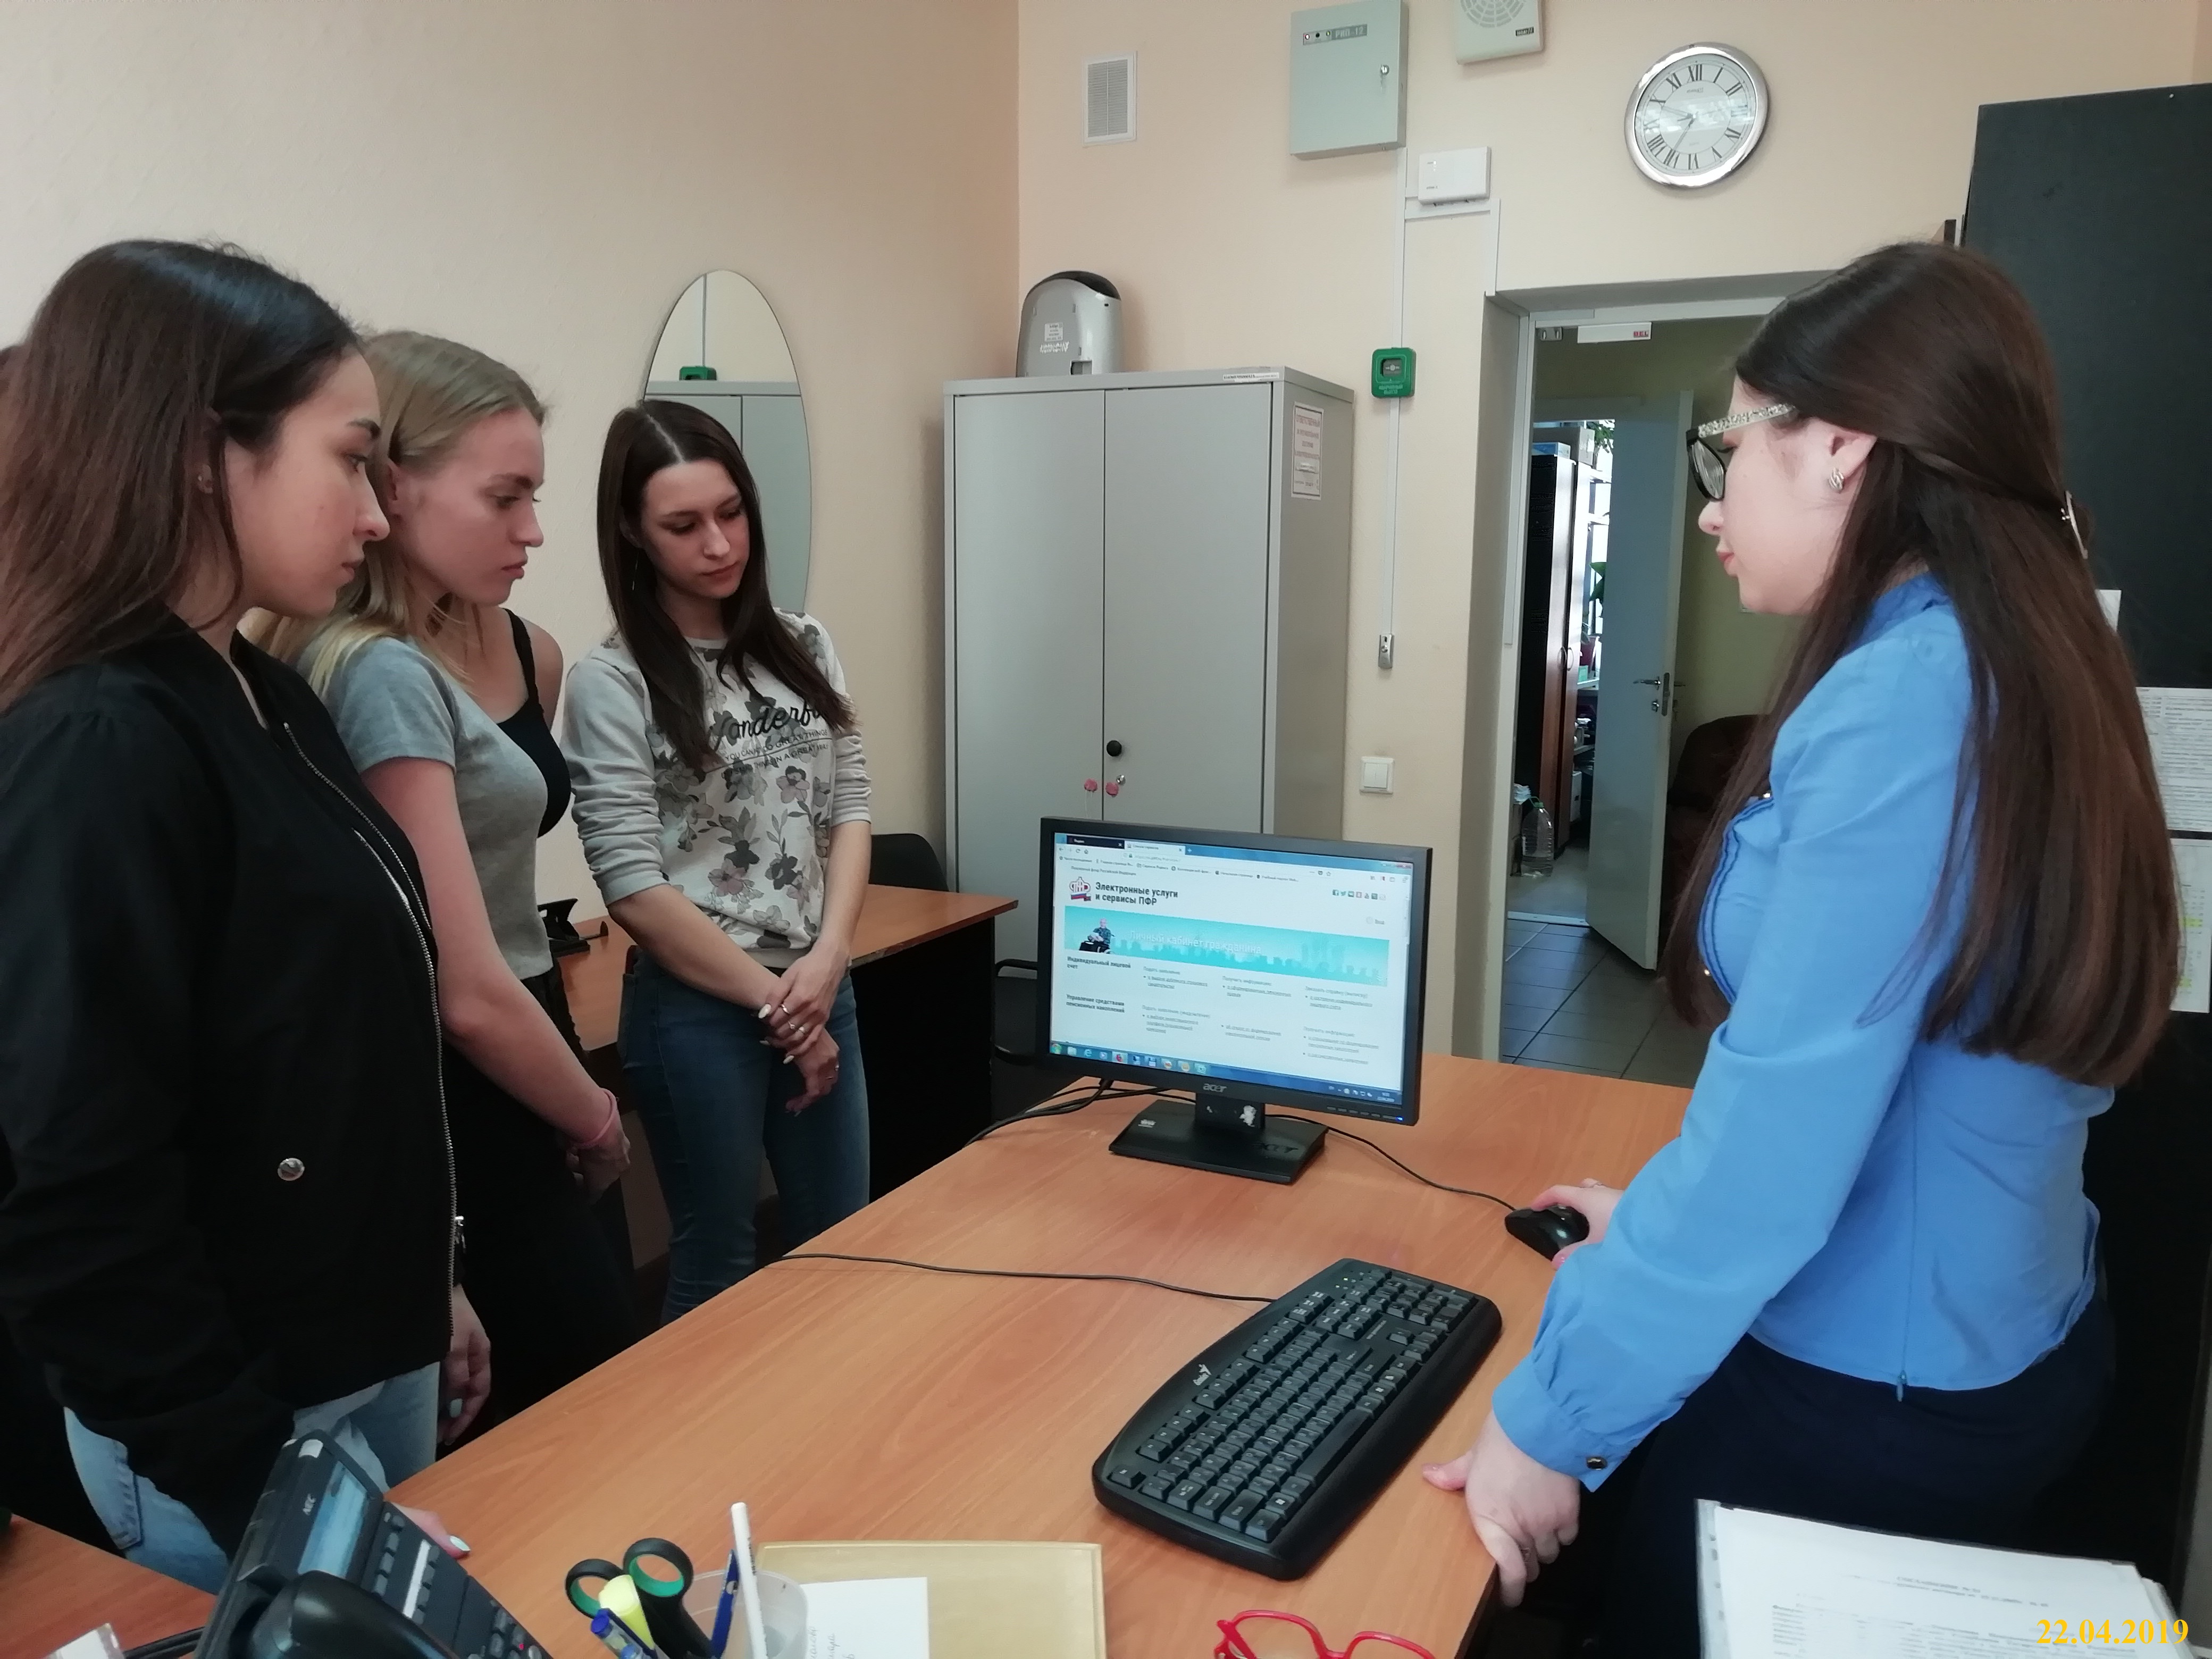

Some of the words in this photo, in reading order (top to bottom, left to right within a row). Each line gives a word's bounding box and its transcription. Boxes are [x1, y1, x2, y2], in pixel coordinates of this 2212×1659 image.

[1687, 64, 1703, 83] XII
[1095, 882, 1150, 895] Электронные
[1152, 889, 1178, 899] услуги
[1102, 894, 1136, 904] сервисы
[1138, 896, 1157, 906] ПФР
[1130, 931, 1164, 944] Личный
[1168, 935, 1204, 948] кабинет
[1204, 941, 1262, 954] гражданина
[1203, 1083, 1227, 1093] acer
